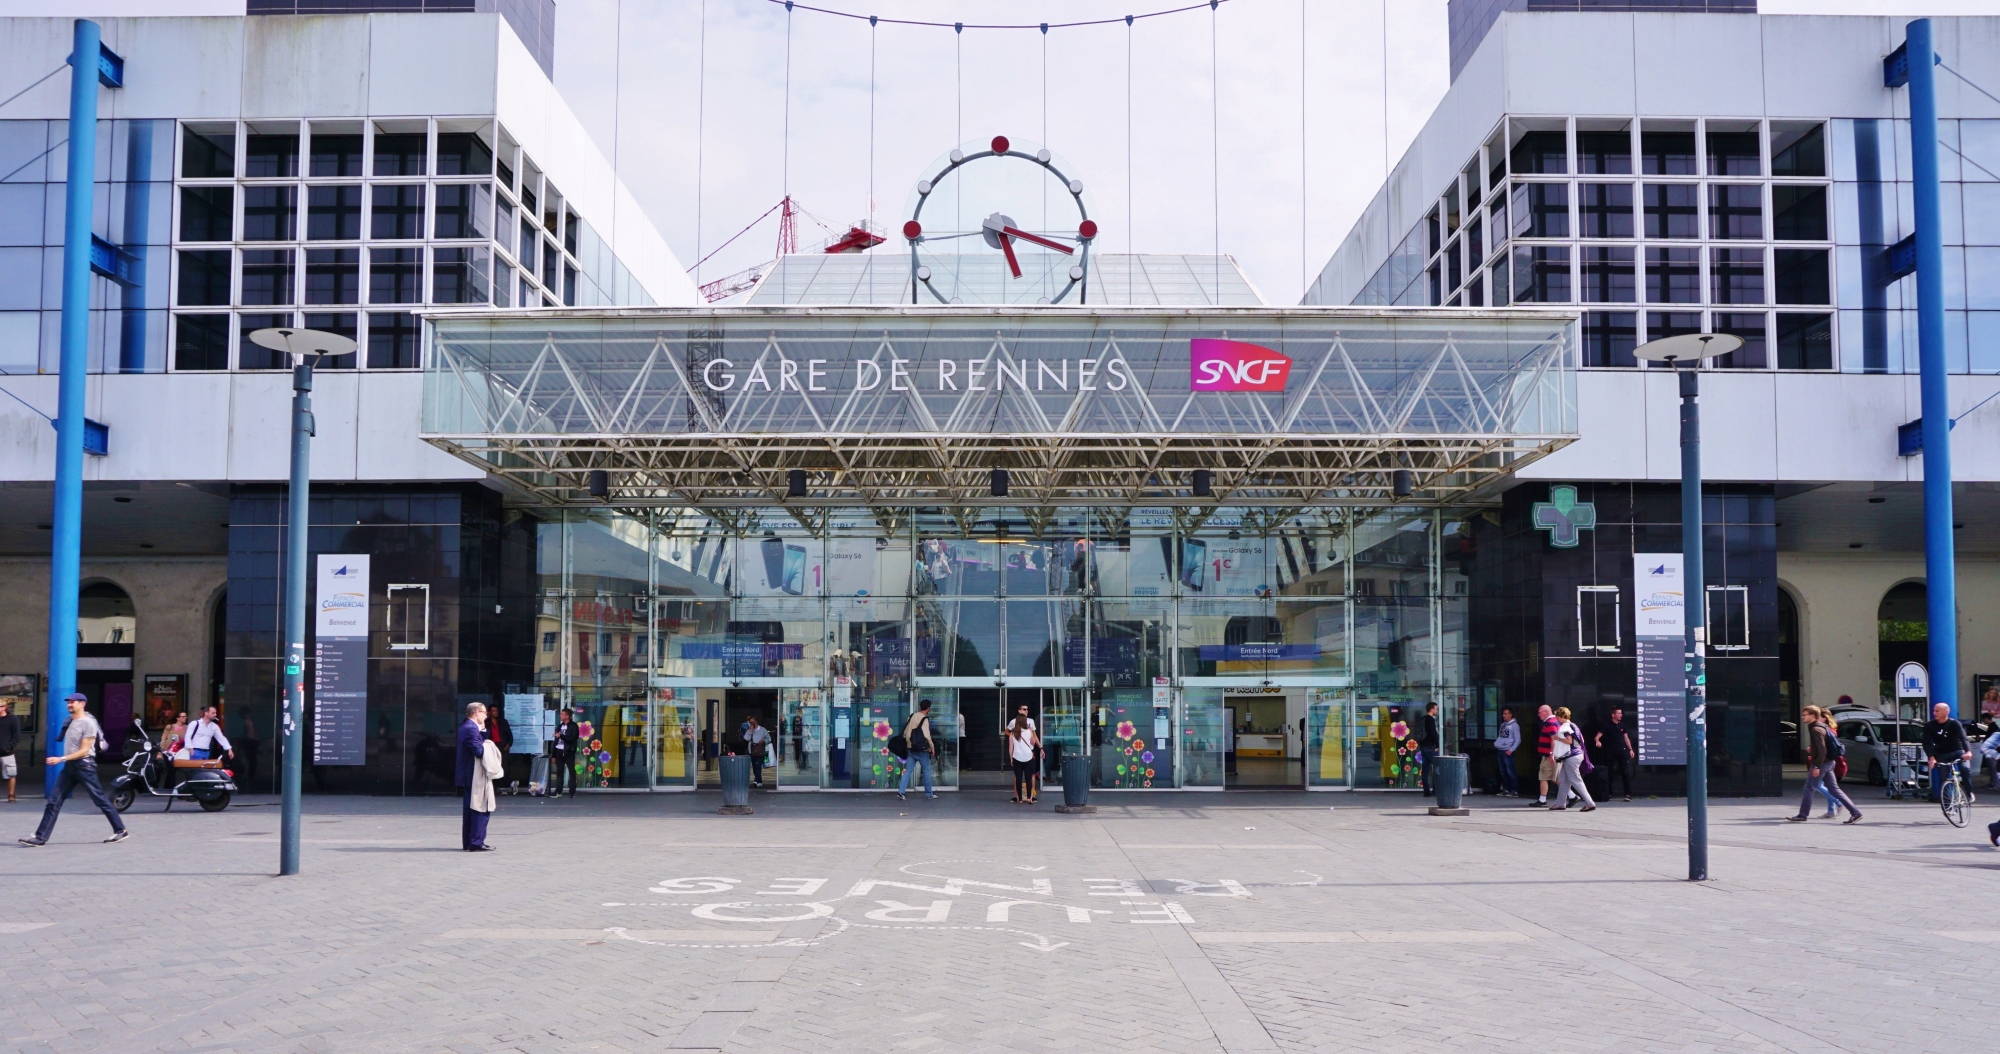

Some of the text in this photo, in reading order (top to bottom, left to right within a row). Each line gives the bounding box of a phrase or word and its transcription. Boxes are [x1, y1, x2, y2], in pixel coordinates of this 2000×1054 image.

[703, 358, 1128, 391] GARE DE RENNES
[1195, 359, 1287, 384] SNCF
[1228, 547, 1253, 555] Galaxy
[333, 594, 355, 602] ESPACE
[1652, 593, 1673, 601] ESPACE
[322, 600, 365, 608] COMMERCIAL
[1641, 599, 1684, 607] COMMERCIAL
[329, 618, 357, 626] BIENVENUE
[1648, 617, 1677, 625] BIENVENUE
